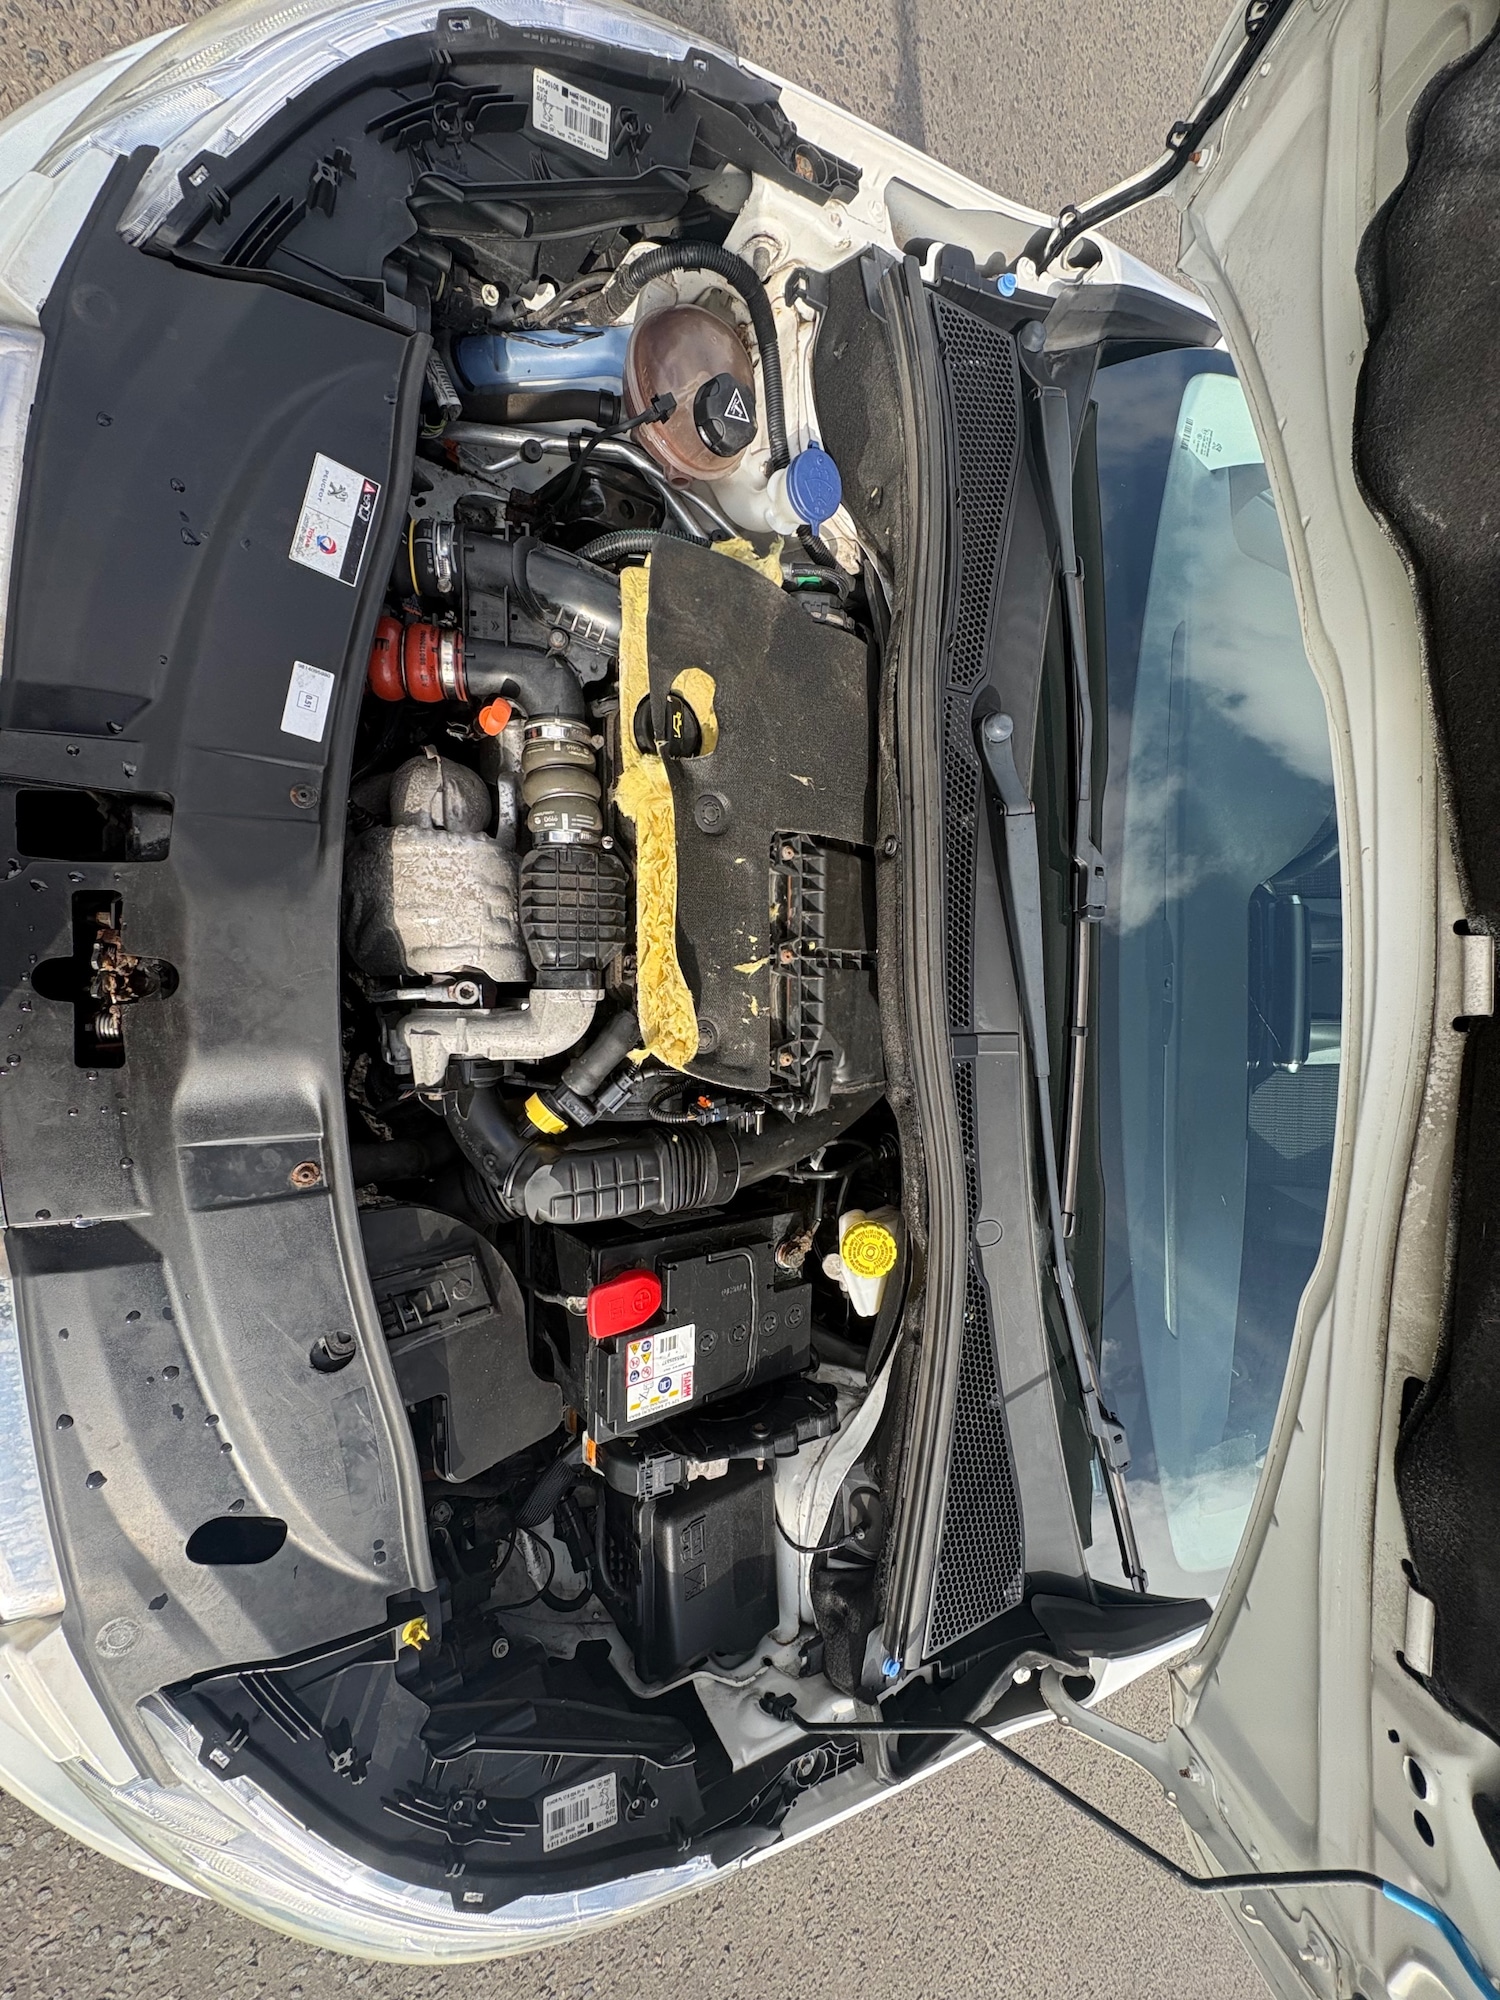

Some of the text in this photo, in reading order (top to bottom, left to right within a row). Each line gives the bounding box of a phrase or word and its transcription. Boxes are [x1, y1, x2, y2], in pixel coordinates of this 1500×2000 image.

[317, 469, 330, 502] PEUGEOT
[304, 694, 313, 708] 0.51
[683, 1371, 692, 1398] FIAMM
